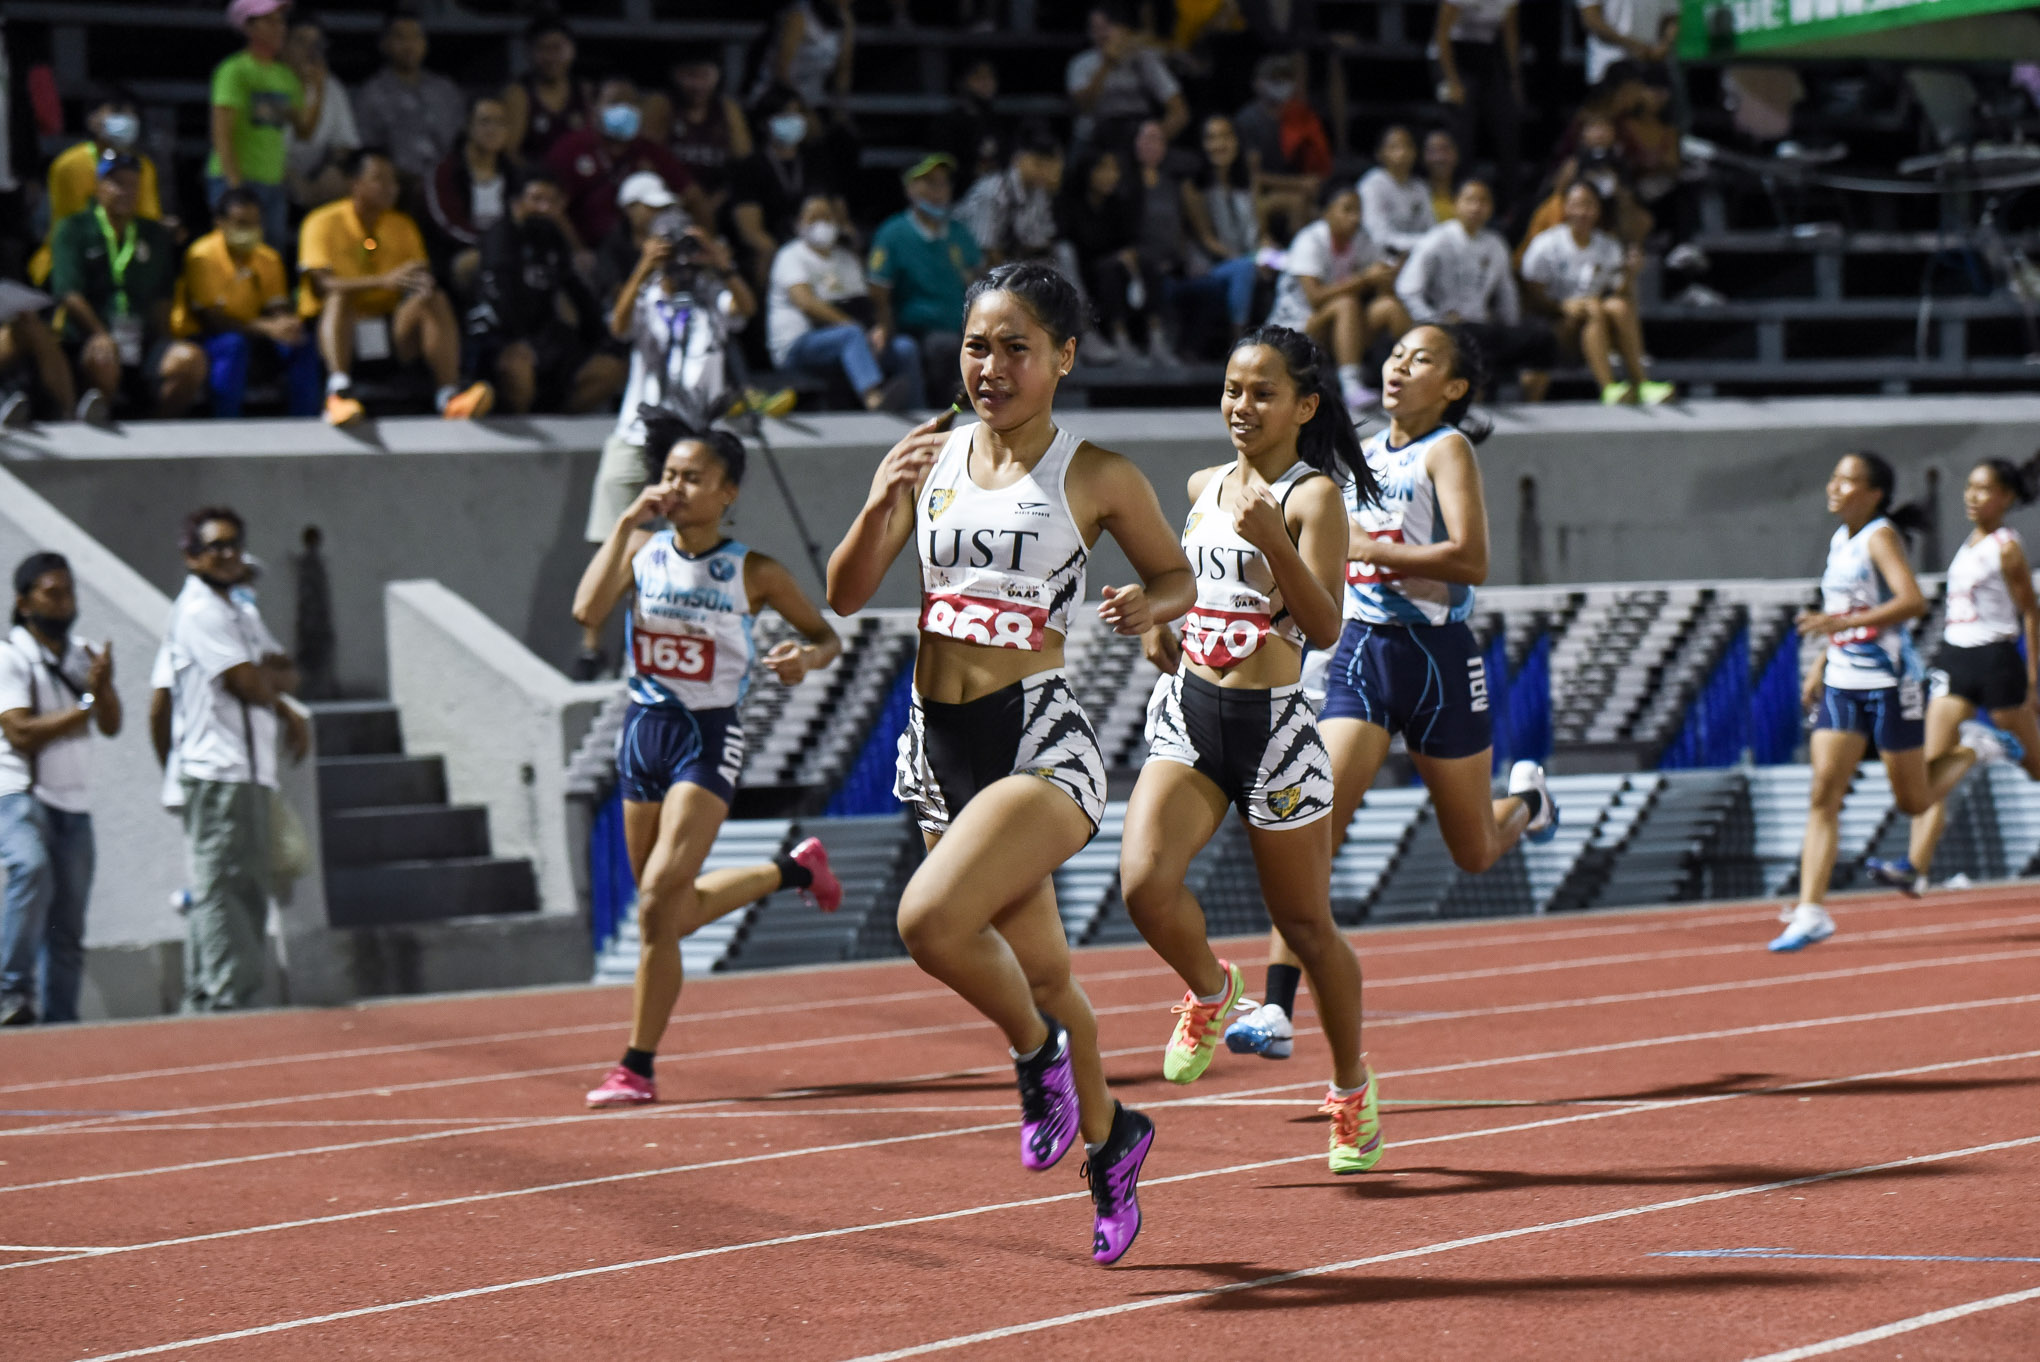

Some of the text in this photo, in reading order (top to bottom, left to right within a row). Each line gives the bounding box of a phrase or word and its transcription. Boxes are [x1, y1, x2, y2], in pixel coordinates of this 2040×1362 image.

[928, 528, 1039, 572] UST
[1007, 590, 1040, 598] UAAP
[636, 635, 705, 675] 163
